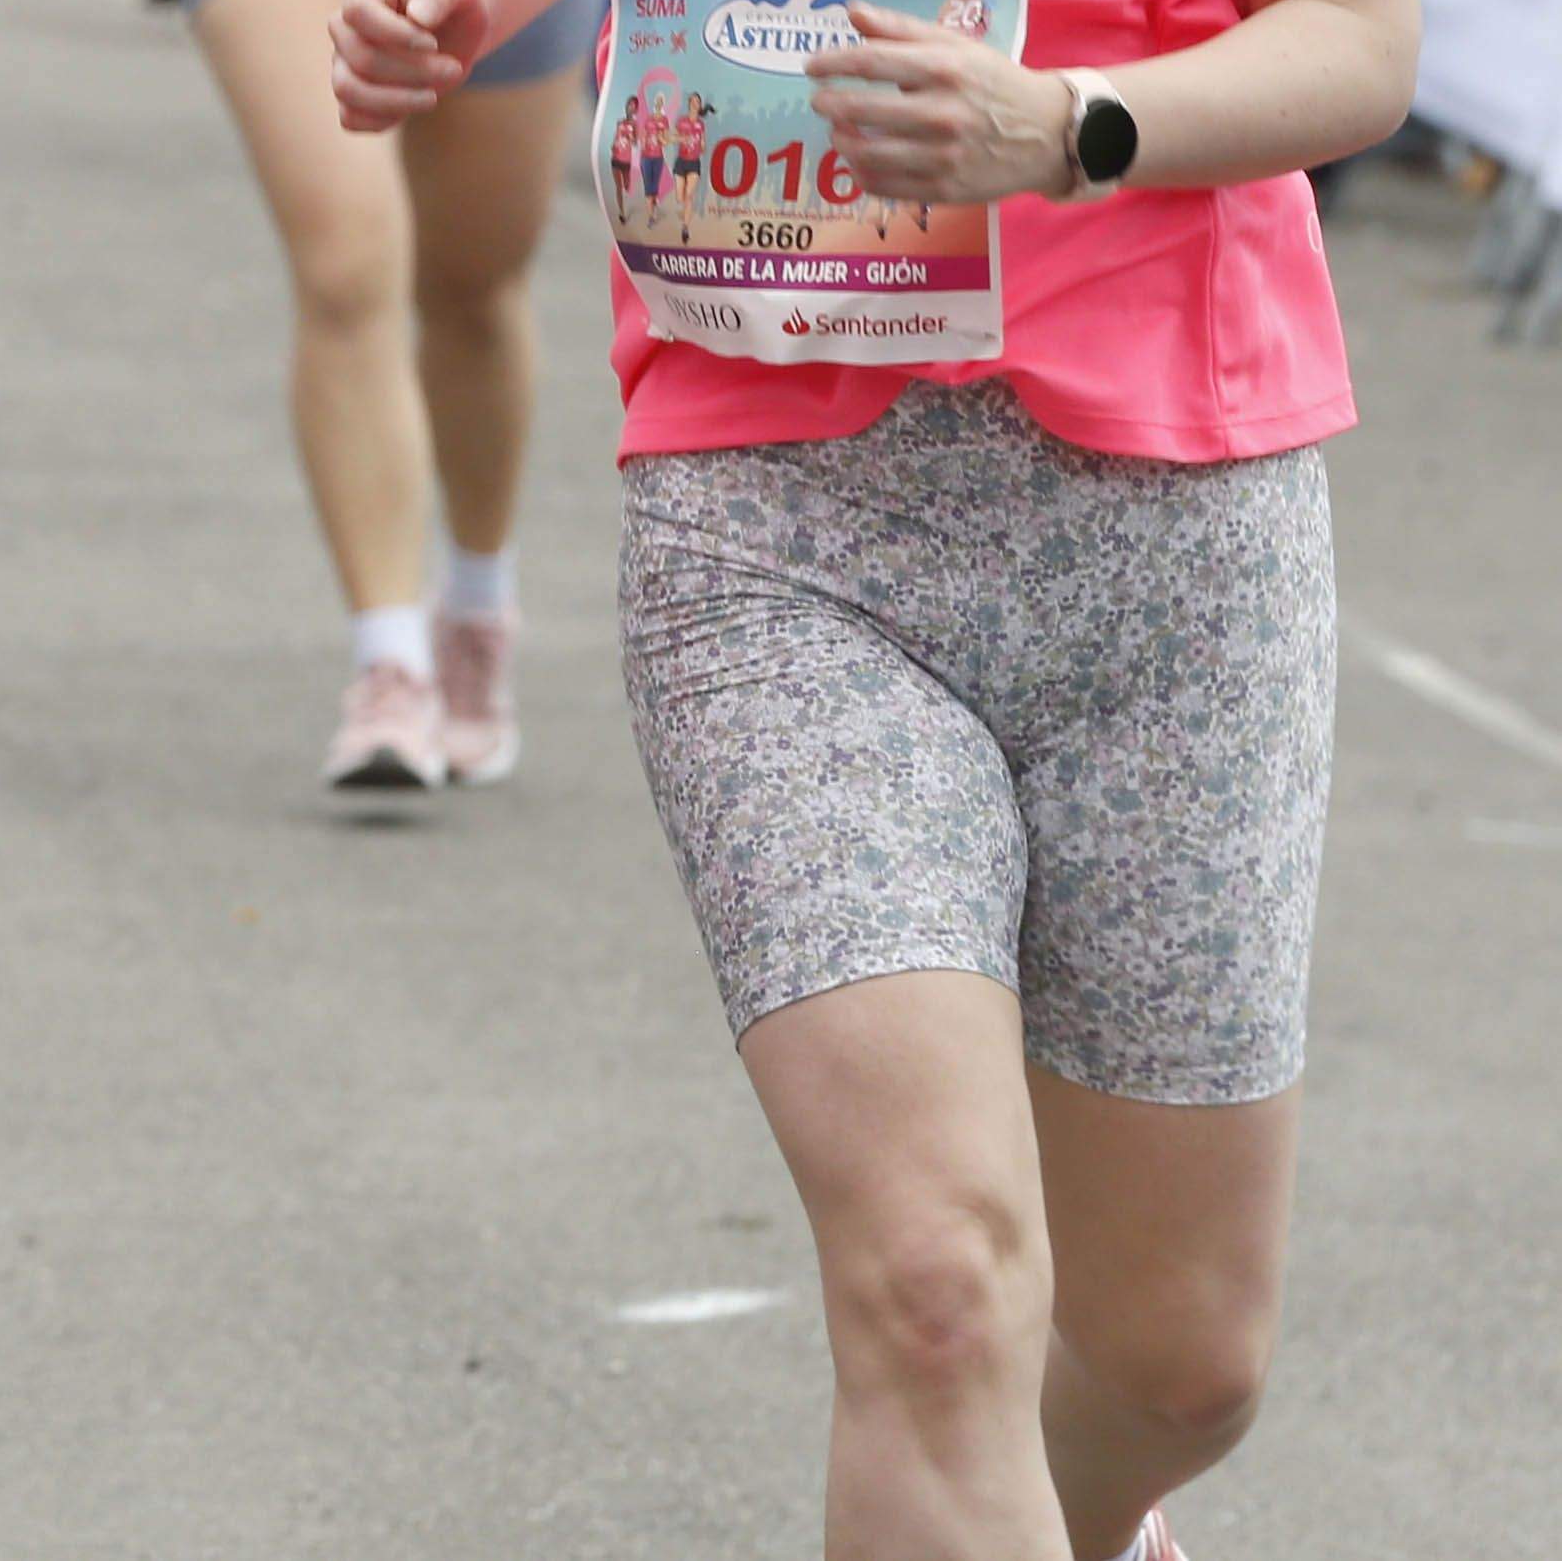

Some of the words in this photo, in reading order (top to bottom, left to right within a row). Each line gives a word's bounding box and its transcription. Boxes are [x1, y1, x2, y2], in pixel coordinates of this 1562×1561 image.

[716, 13, 863, 52] ASTURIAN
[710, 136, 863, 205] 016
[738, 220, 813, 251] 3660
[652, 253, 717, 279] CARRERA
[723, 258, 745, 280] DE
[750, 259, 776, 282] LA
[782, 260, 848, 283] MUJER
[867, 256, 926, 285] GIJÓN
[816, 312, 948, 336] Santander
